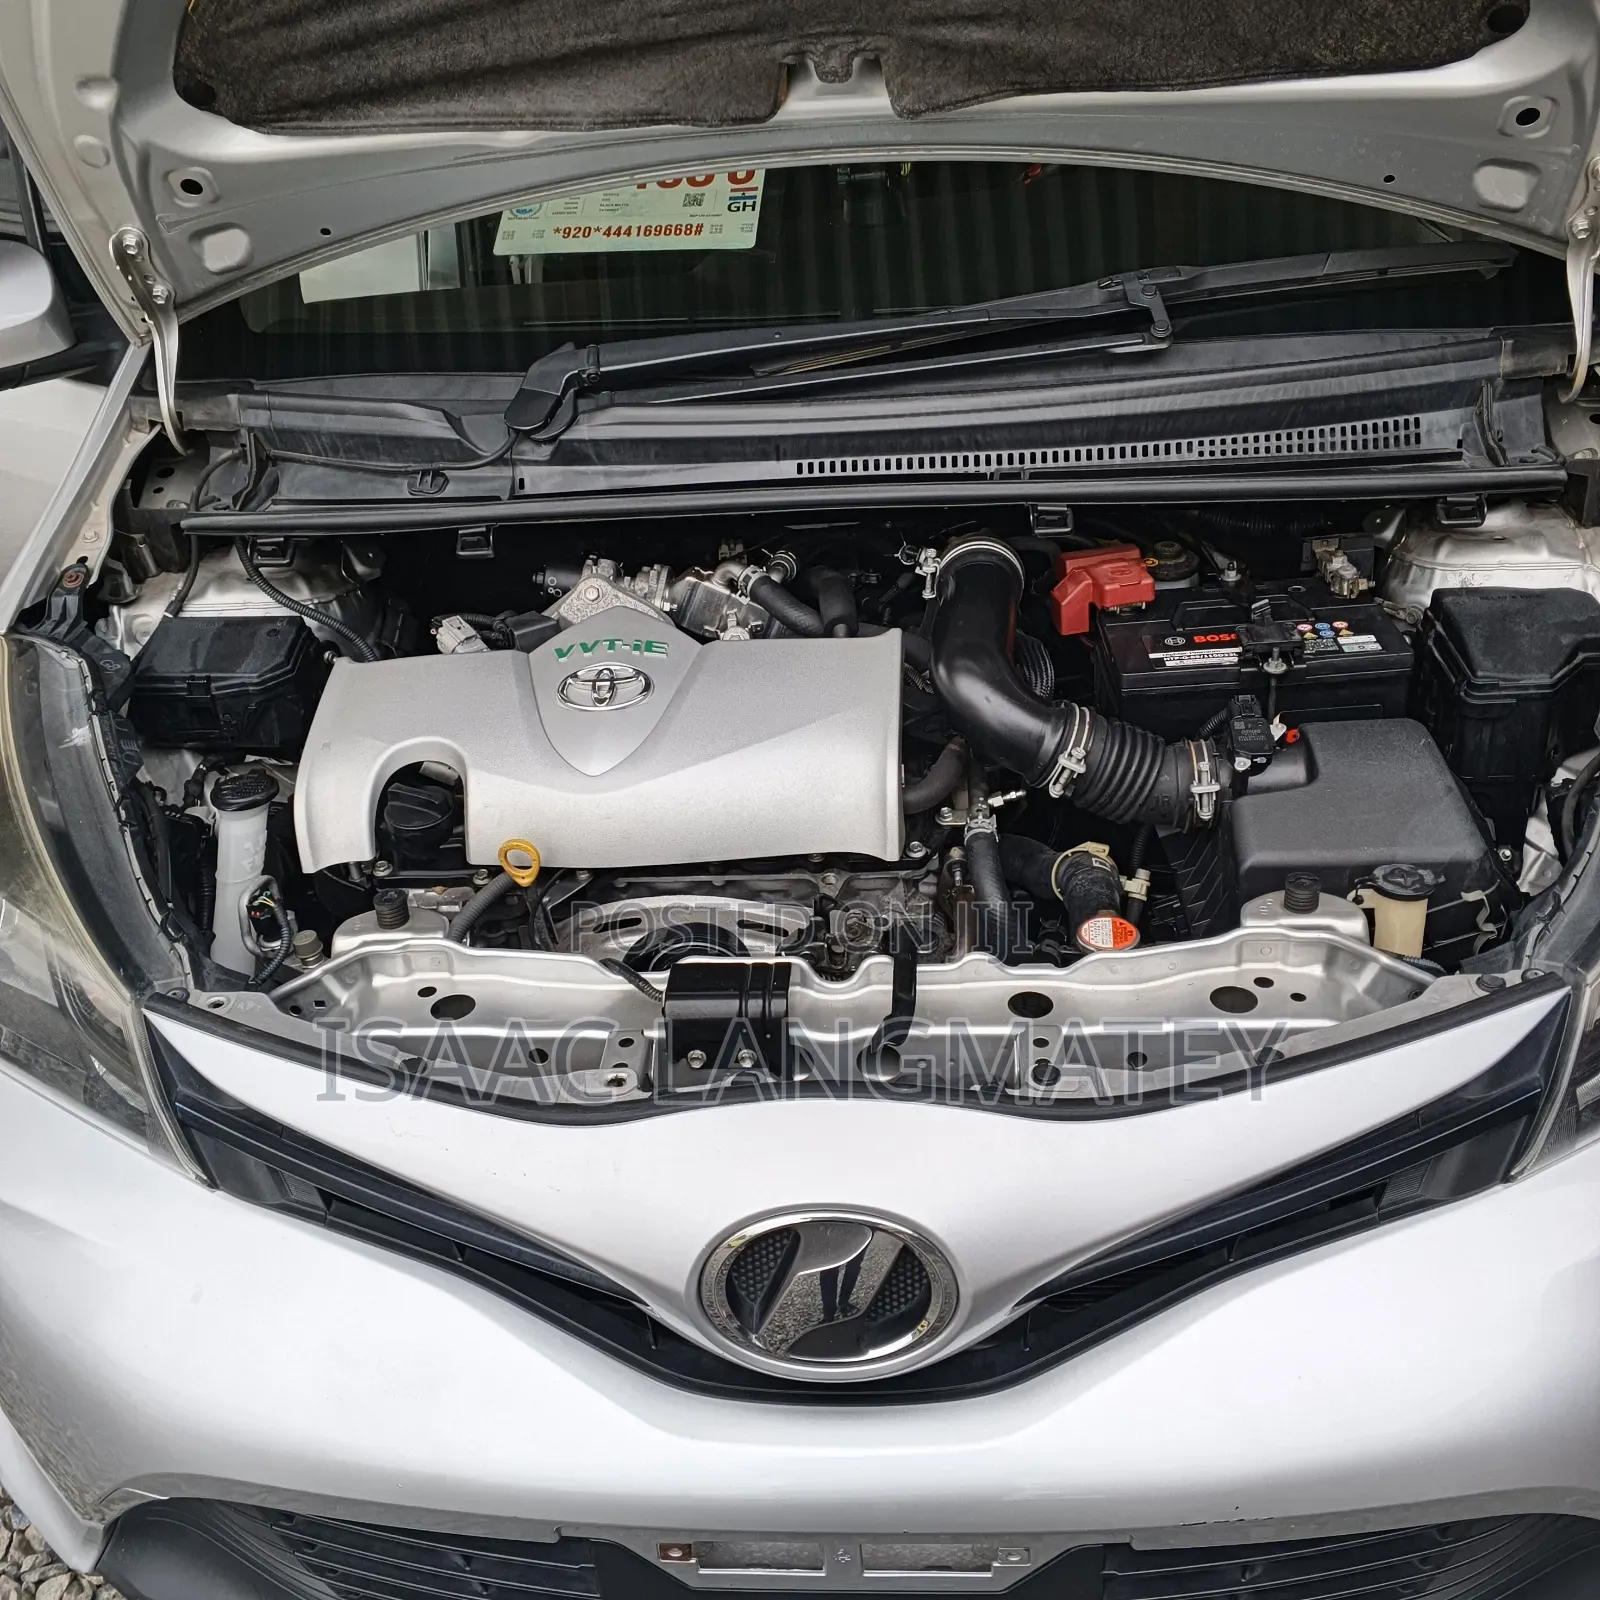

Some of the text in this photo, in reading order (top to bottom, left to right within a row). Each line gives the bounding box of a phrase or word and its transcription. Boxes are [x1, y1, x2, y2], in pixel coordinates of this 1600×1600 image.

[727, 201, 756, 213] GH
[1193, 633, 1237, 643] BOSC
[554, 639, 668, 662] VVT-iE
